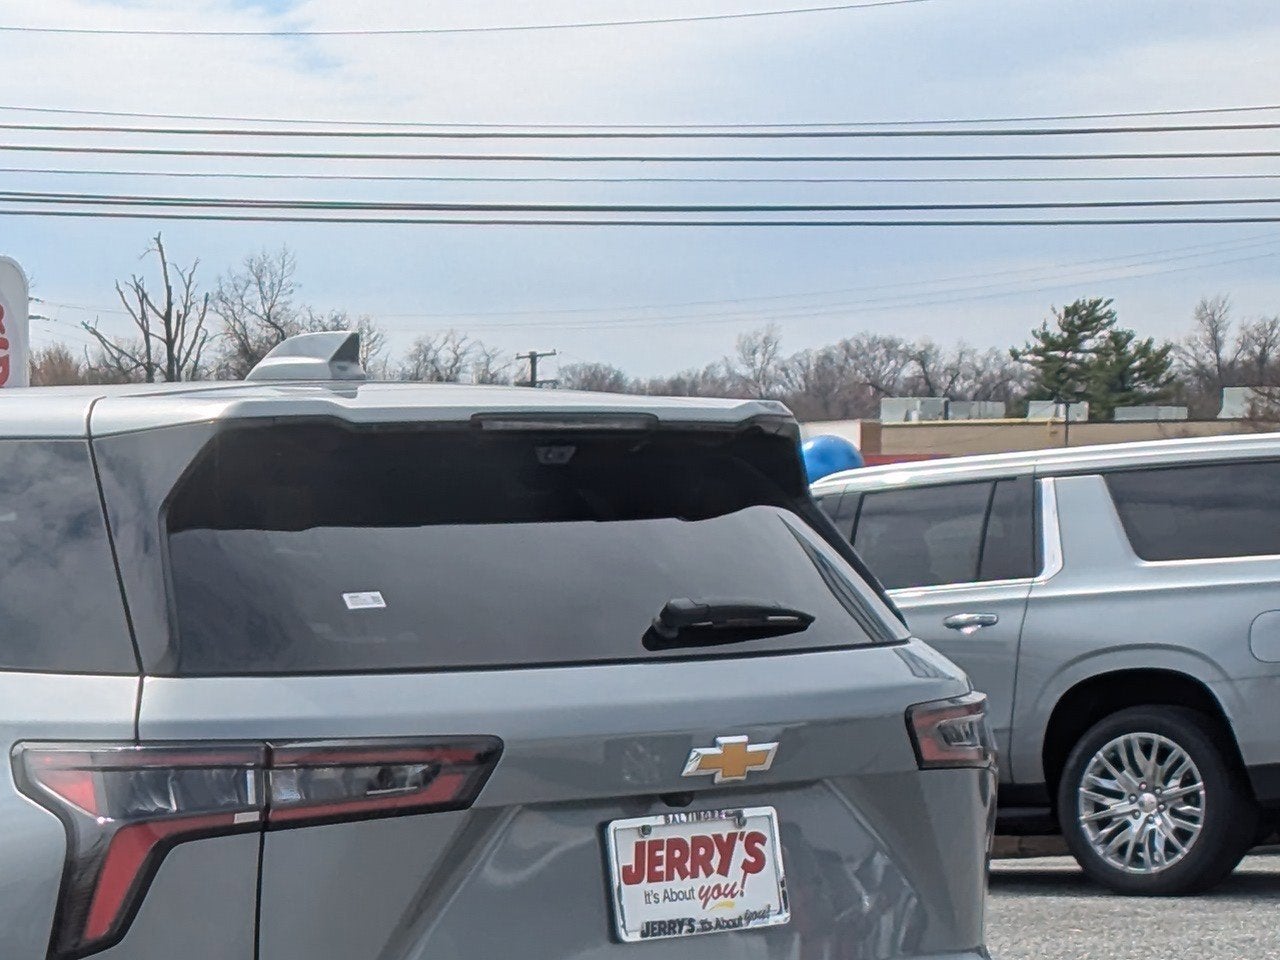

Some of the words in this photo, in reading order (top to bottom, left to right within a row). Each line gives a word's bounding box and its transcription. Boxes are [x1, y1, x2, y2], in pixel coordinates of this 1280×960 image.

[622, 830, 768, 886] JERRY'S
[644, 890, 661, 905] It's
[663, 886, 695, 902] About
[698, 870, 745, 910] you!
